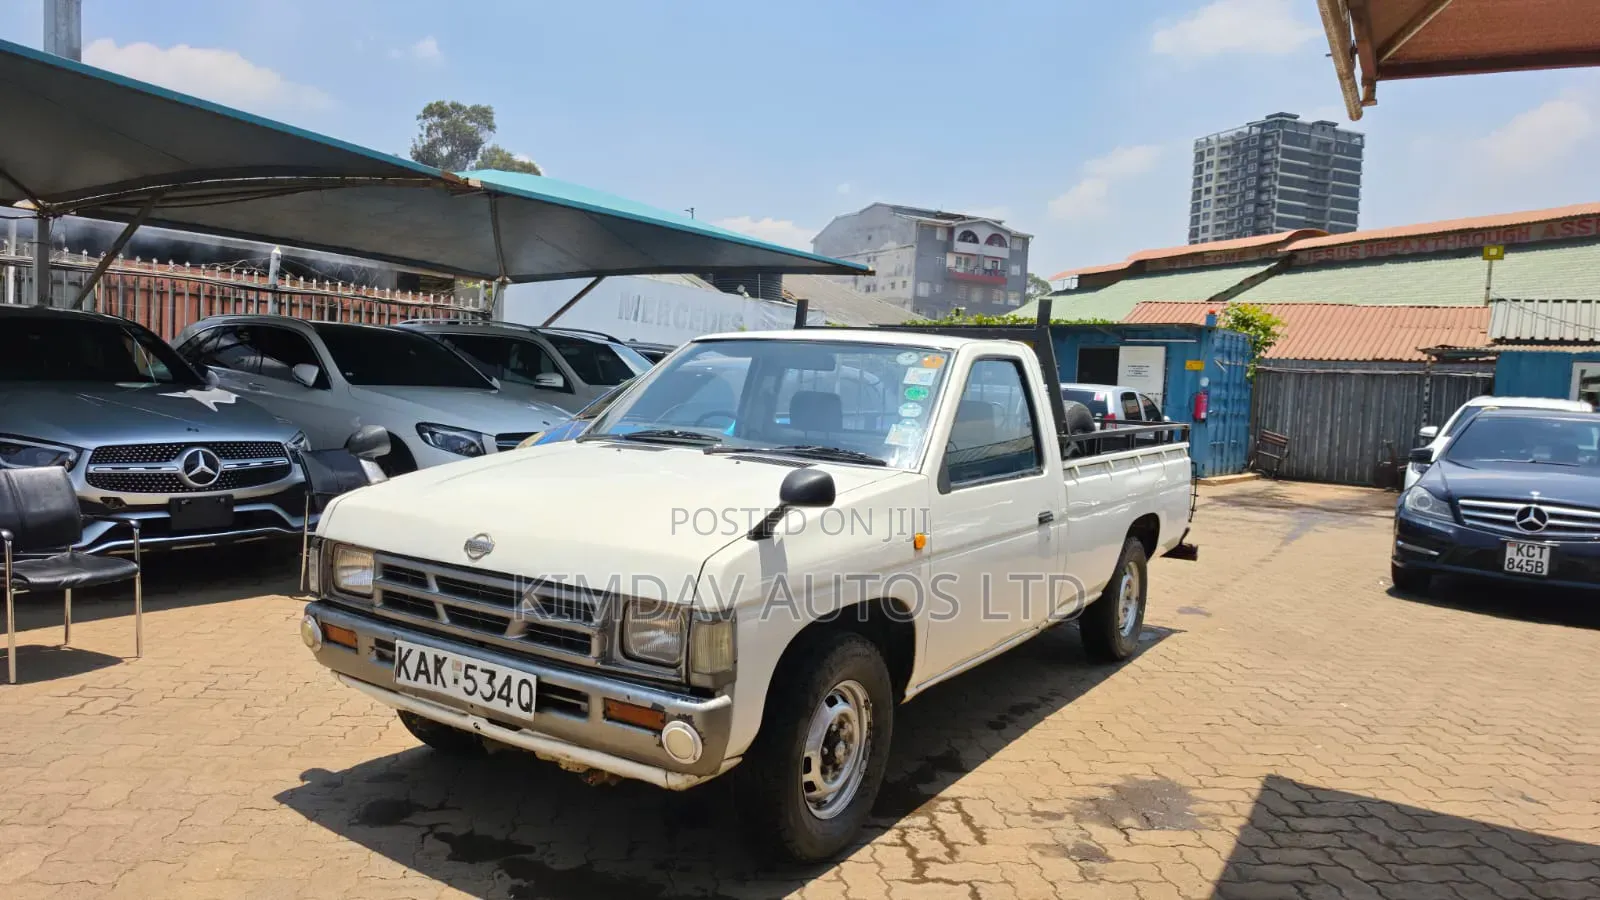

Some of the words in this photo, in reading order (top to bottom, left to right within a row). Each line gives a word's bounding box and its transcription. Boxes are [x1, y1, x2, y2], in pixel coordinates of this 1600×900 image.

[1304, 245, 1360, 263] JESUS
[1365, 226, 1531, 258] BREAKTHROUGH
[618, 290, 744, 332] MERCEDES
[1506, 557, 1545, 574] 845B
[1516, 543, 1547, 559] KCT
[397, 646, 448, 689] KAK
[463, 663, 534, 714] 534Q
